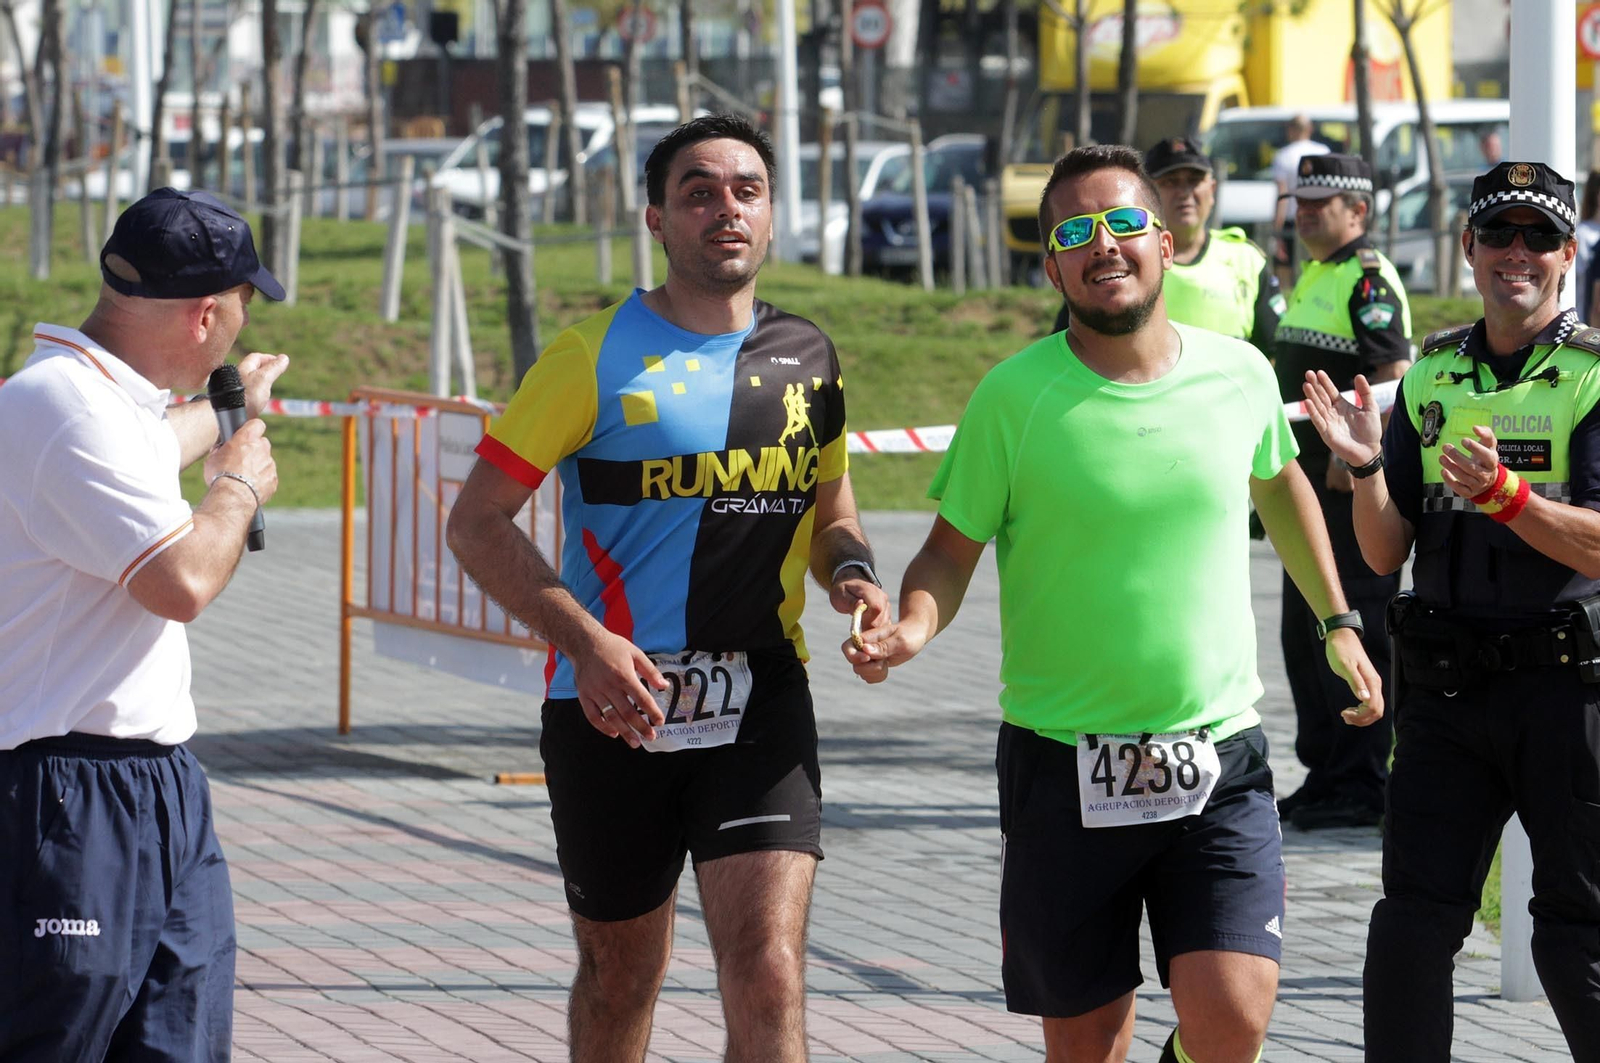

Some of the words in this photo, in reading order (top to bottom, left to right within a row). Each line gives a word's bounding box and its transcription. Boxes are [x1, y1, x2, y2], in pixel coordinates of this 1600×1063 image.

[778, 357, 801, 366] SPALL
[1492, 415, 1553, 433] POLICIA
[1497, 444, 1521, 452] POLICIA
[1523, 444, 1544, 452] LOCAL
[641, 447, 820, 499] RUNNING
[634, 666, 740, 726] 222
[687, 737, 702, 745] 4222
[1090, 741, 1200, 797] 4238
[1087, 798, 1152, 812] AGRUPACIÓN
[1155, 791, 1208, 807] DEPORTIVA
[1142, 811, 1158, 819] 4238
